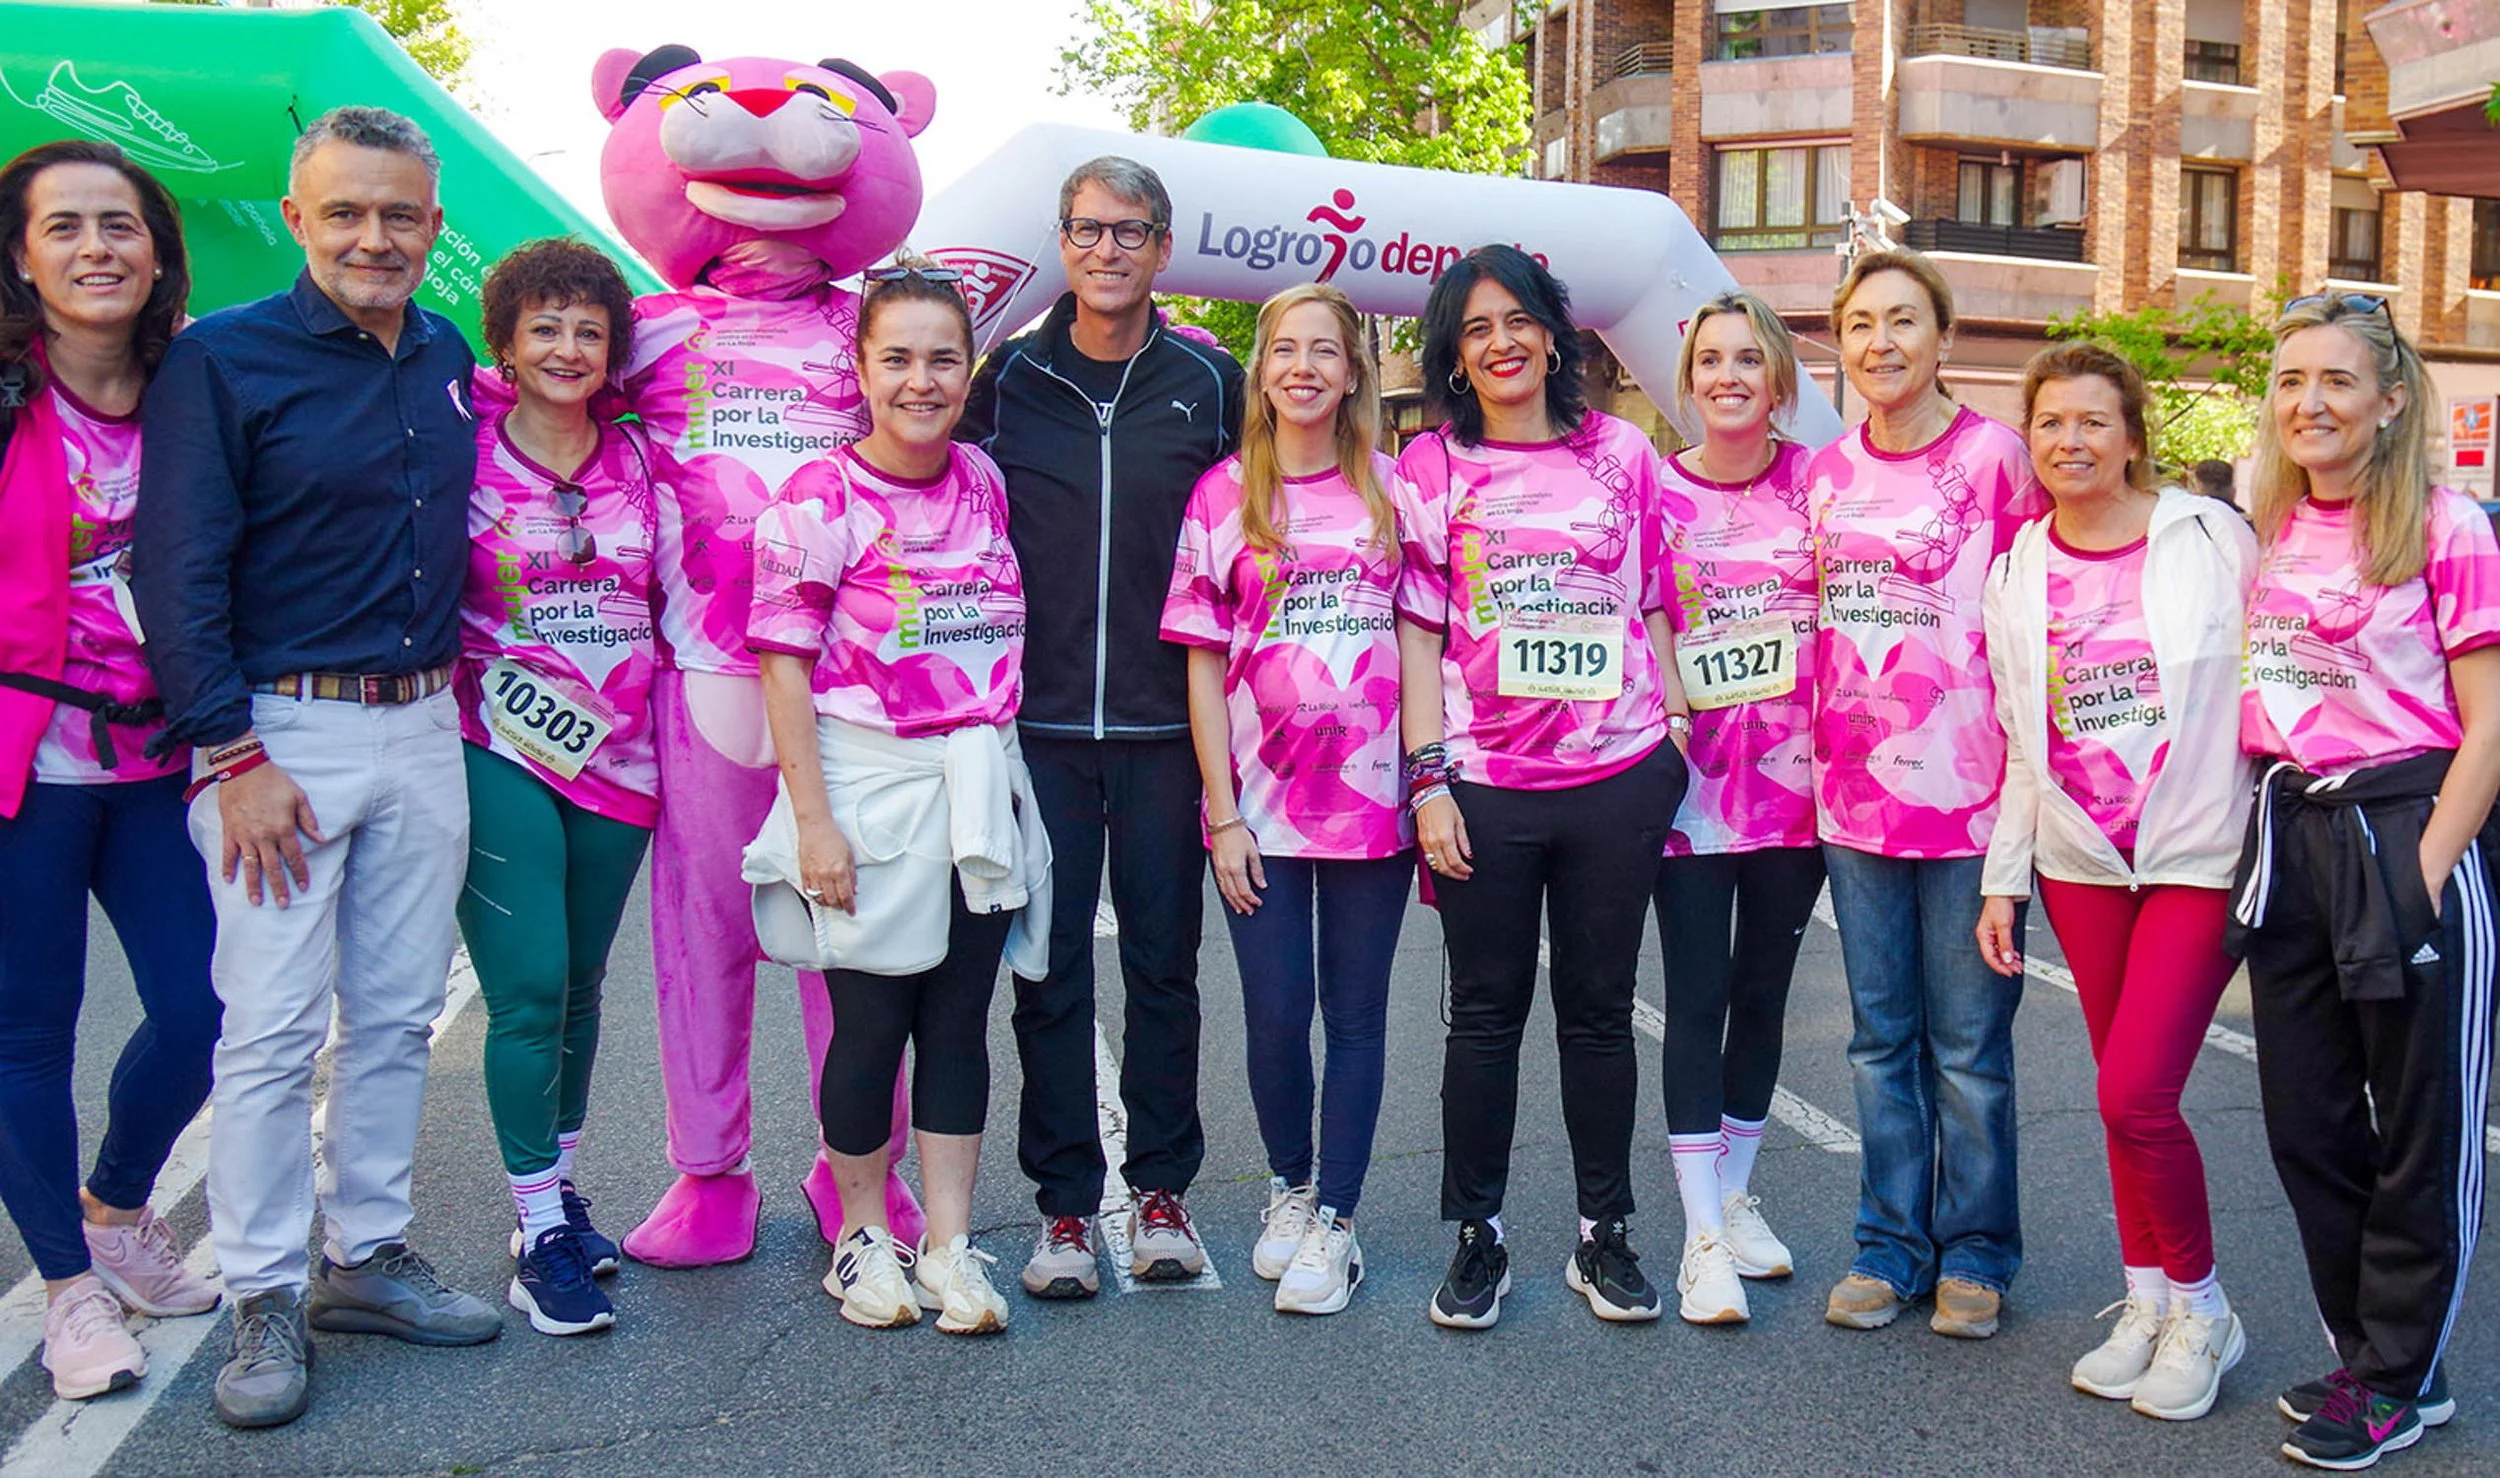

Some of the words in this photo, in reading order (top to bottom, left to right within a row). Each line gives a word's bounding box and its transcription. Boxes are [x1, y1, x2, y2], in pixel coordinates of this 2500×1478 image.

[432, 251, 454, 269] el
[711, 360, 735, 377] XI
[711, 381, 804, 402] Carrera
[682, 361, 713, 449] mujer
[711, 408, 752, 427] por
[758, 407, 780, 425] la
[1485, 529, 1506, 546] XI
[1823, 532, 1842, 549] XI
[526, 551, 550, 570] XI
[1276, 545, 1299, 565] XI
[1486, 550, 1573, 570] Carrera
[1823, 556, 1893, 574] Carrera
[1285, 567, 1359, 587] Carrera
[1460, 532, 1497, 625] mujer
[1696, 561, 1717, 577] XI
[493, 550, 533, 640] mujer
[527, 576, 616, 595] Carrera
[919, 580, 991, 597] Carrera
[1490, 579, 1527, 599] por
[1531, 574, 1551, 593] la
[1700, 578, 1780, 600] Carrera
[1826, 583, 1852, 601] por
[1857, 580, 1875, 599] la
[530, 605, 568, 627] por
[574, 600, 595, 619] la
[886, 562, 924, 649] mujer
[924, 606, 955, 626] por
[956, 602, 981, 619] la
[1284, 596, 1317, 616] por
[1321, 591, 1339, 608] la
[1741, 605, 1760, 620] la
[1284, 613, 1394, 636] Investigació
[2062, 640, 2084, 660] XI
[2250, 640, 2268, 655] or
[2271, 637, 2287, 656] la
[1512, 638, 1608, 678] 11319
[1693, 639, 1782, 686] 11327
[2063, 657, 2152, 685] Carrera
[2068, 690, 2105, 714] por
[2109, 684, 2134, 702] la
[494, 670, 596, 754] 10303
